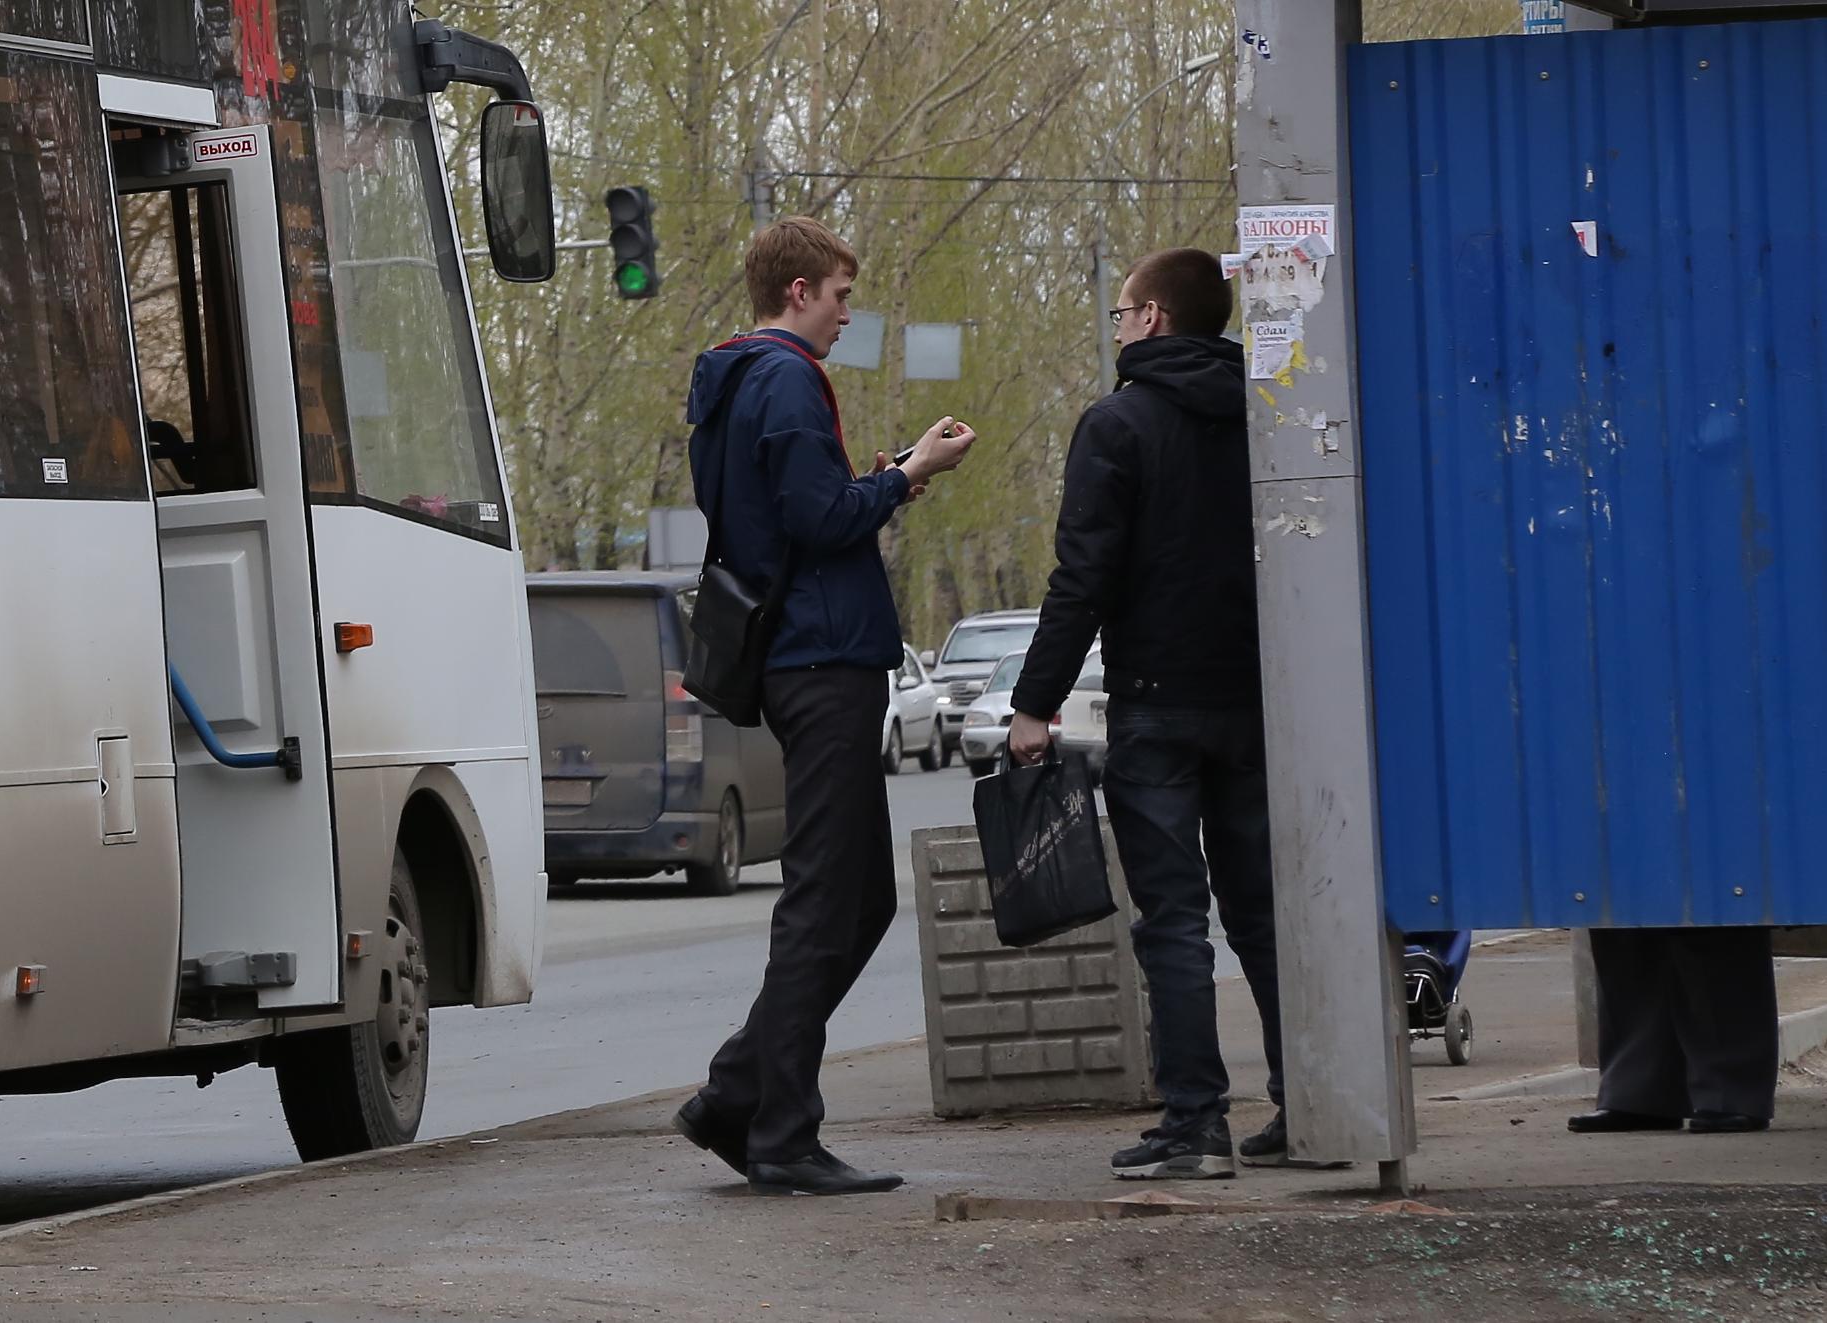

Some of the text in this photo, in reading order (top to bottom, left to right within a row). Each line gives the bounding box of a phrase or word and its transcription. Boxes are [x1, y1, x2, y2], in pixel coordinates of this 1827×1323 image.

[200, 140, 252, 156] ВЫХОД
[1244, 220, 1328, 236] БАЛКОНЫ
[1256, 325, 1287, 336] Сдам
